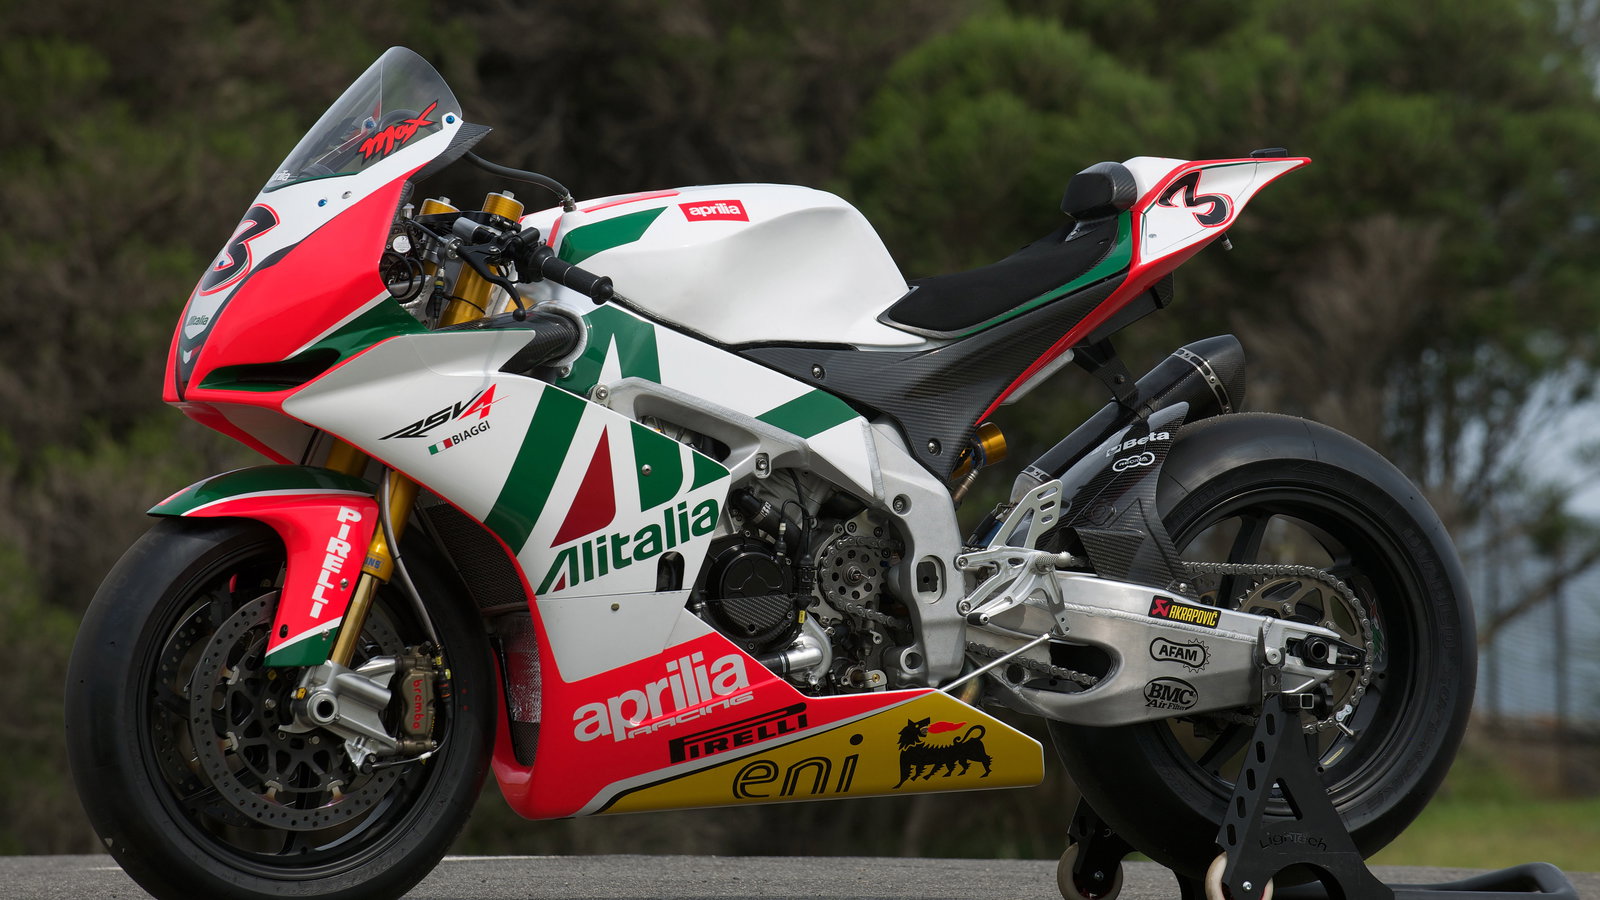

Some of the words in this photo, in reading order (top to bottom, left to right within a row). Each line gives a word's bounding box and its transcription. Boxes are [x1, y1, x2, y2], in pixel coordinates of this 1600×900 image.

[688, 203, 742, 217] aprilia
[1155, 168, 1235, 229] 3
[199, 203, 281, 296] 3
[377, 383, 503, 441] RSV4
[451, 420, 491, 445] BIAGGI
[1123, 431, 1170, 451] Beta
[309, 506, 362, 619] PIRELLI
[535, 498, 720, 596] Alitalia
[1158, 644, 1198, 662] AFAM
[412, 679, 425, 729] brembo
[573, 650, 749, 743] aprilia
[1145, 699, 1167, 709] Air
[1166, 701, 1187, 711] Filter
[1147, 682, 1194, 705] BMC
[668, 702, 808, 764] PIRELLI
[732, 733, 864, 800] eni
